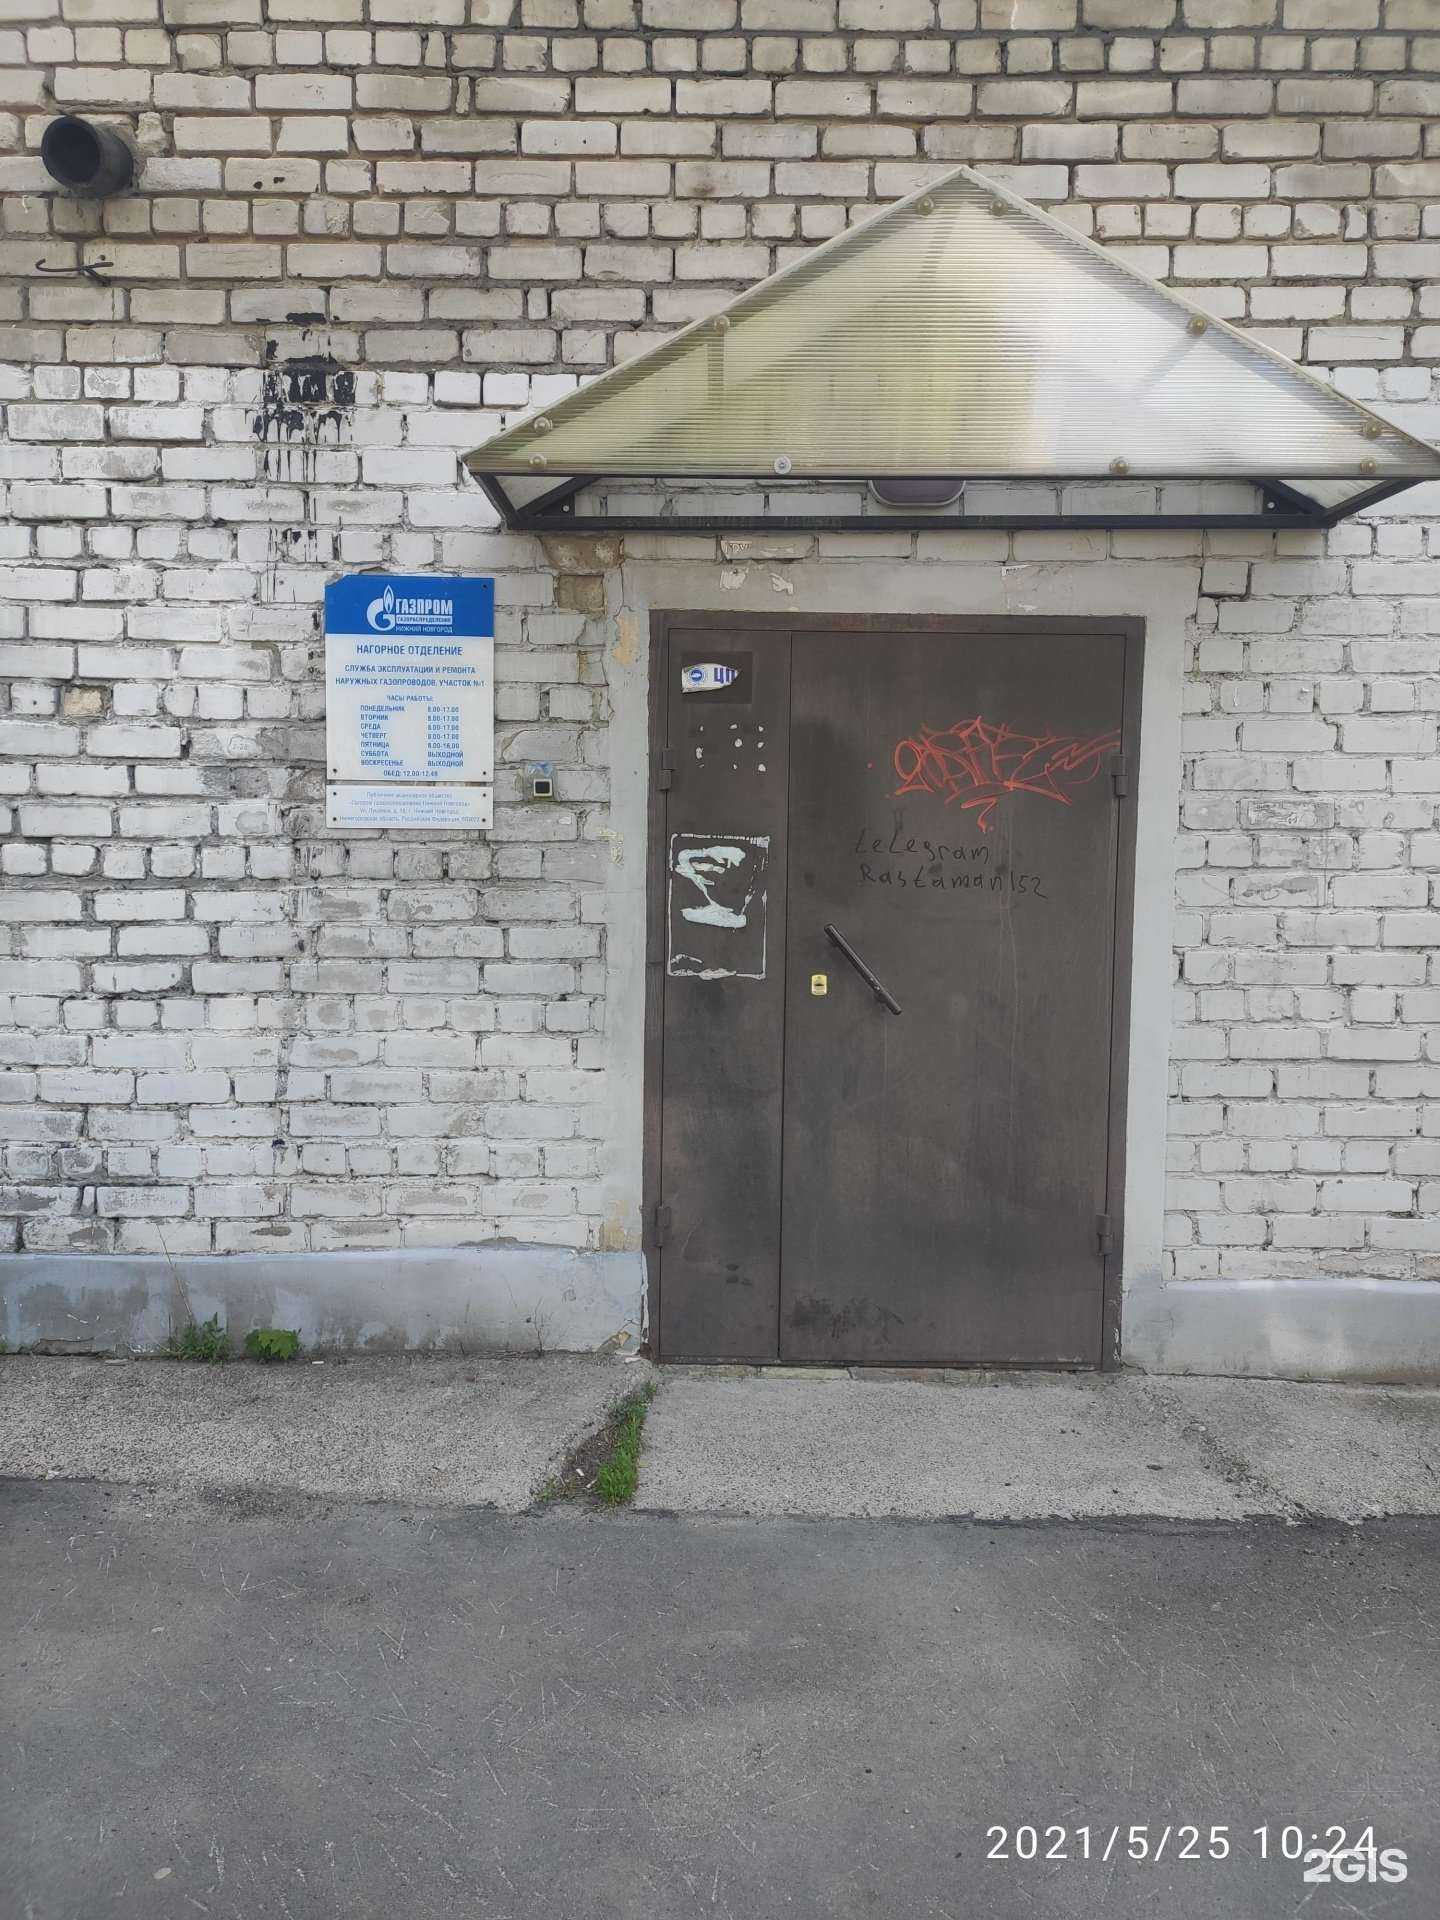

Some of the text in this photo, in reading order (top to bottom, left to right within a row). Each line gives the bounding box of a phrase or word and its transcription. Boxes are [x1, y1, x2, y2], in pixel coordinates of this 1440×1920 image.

[395, 598, 453, 615] ГАЗПРОМ
[395, 625, 422, 633] НИЖНИЙ
[356, 645, 463, 656] НАГОРНОЕ ОТДЕЛЕНИЕ
[344, 664, 476, 674] СЛУЖБА ЭКСПЛУАТАЦИИ И РЕМОНТА
[335, 677, 378, 686] НАРУЖНЫХ
[439, 679, 472, 687] УЧАСТОК
[360, 705, 405, 713] ПОНЕДЕЛЬНИК
[360, 713, 389, 721] ВТОРНИК
[360, 723, 381, 731] СРЕДА
[360, 741, 390, 749] ПЯТНИЦА
[360, 759, 464, 768] ВОСКРЕСЕНЬЕ ВЫХОДНОЙ
